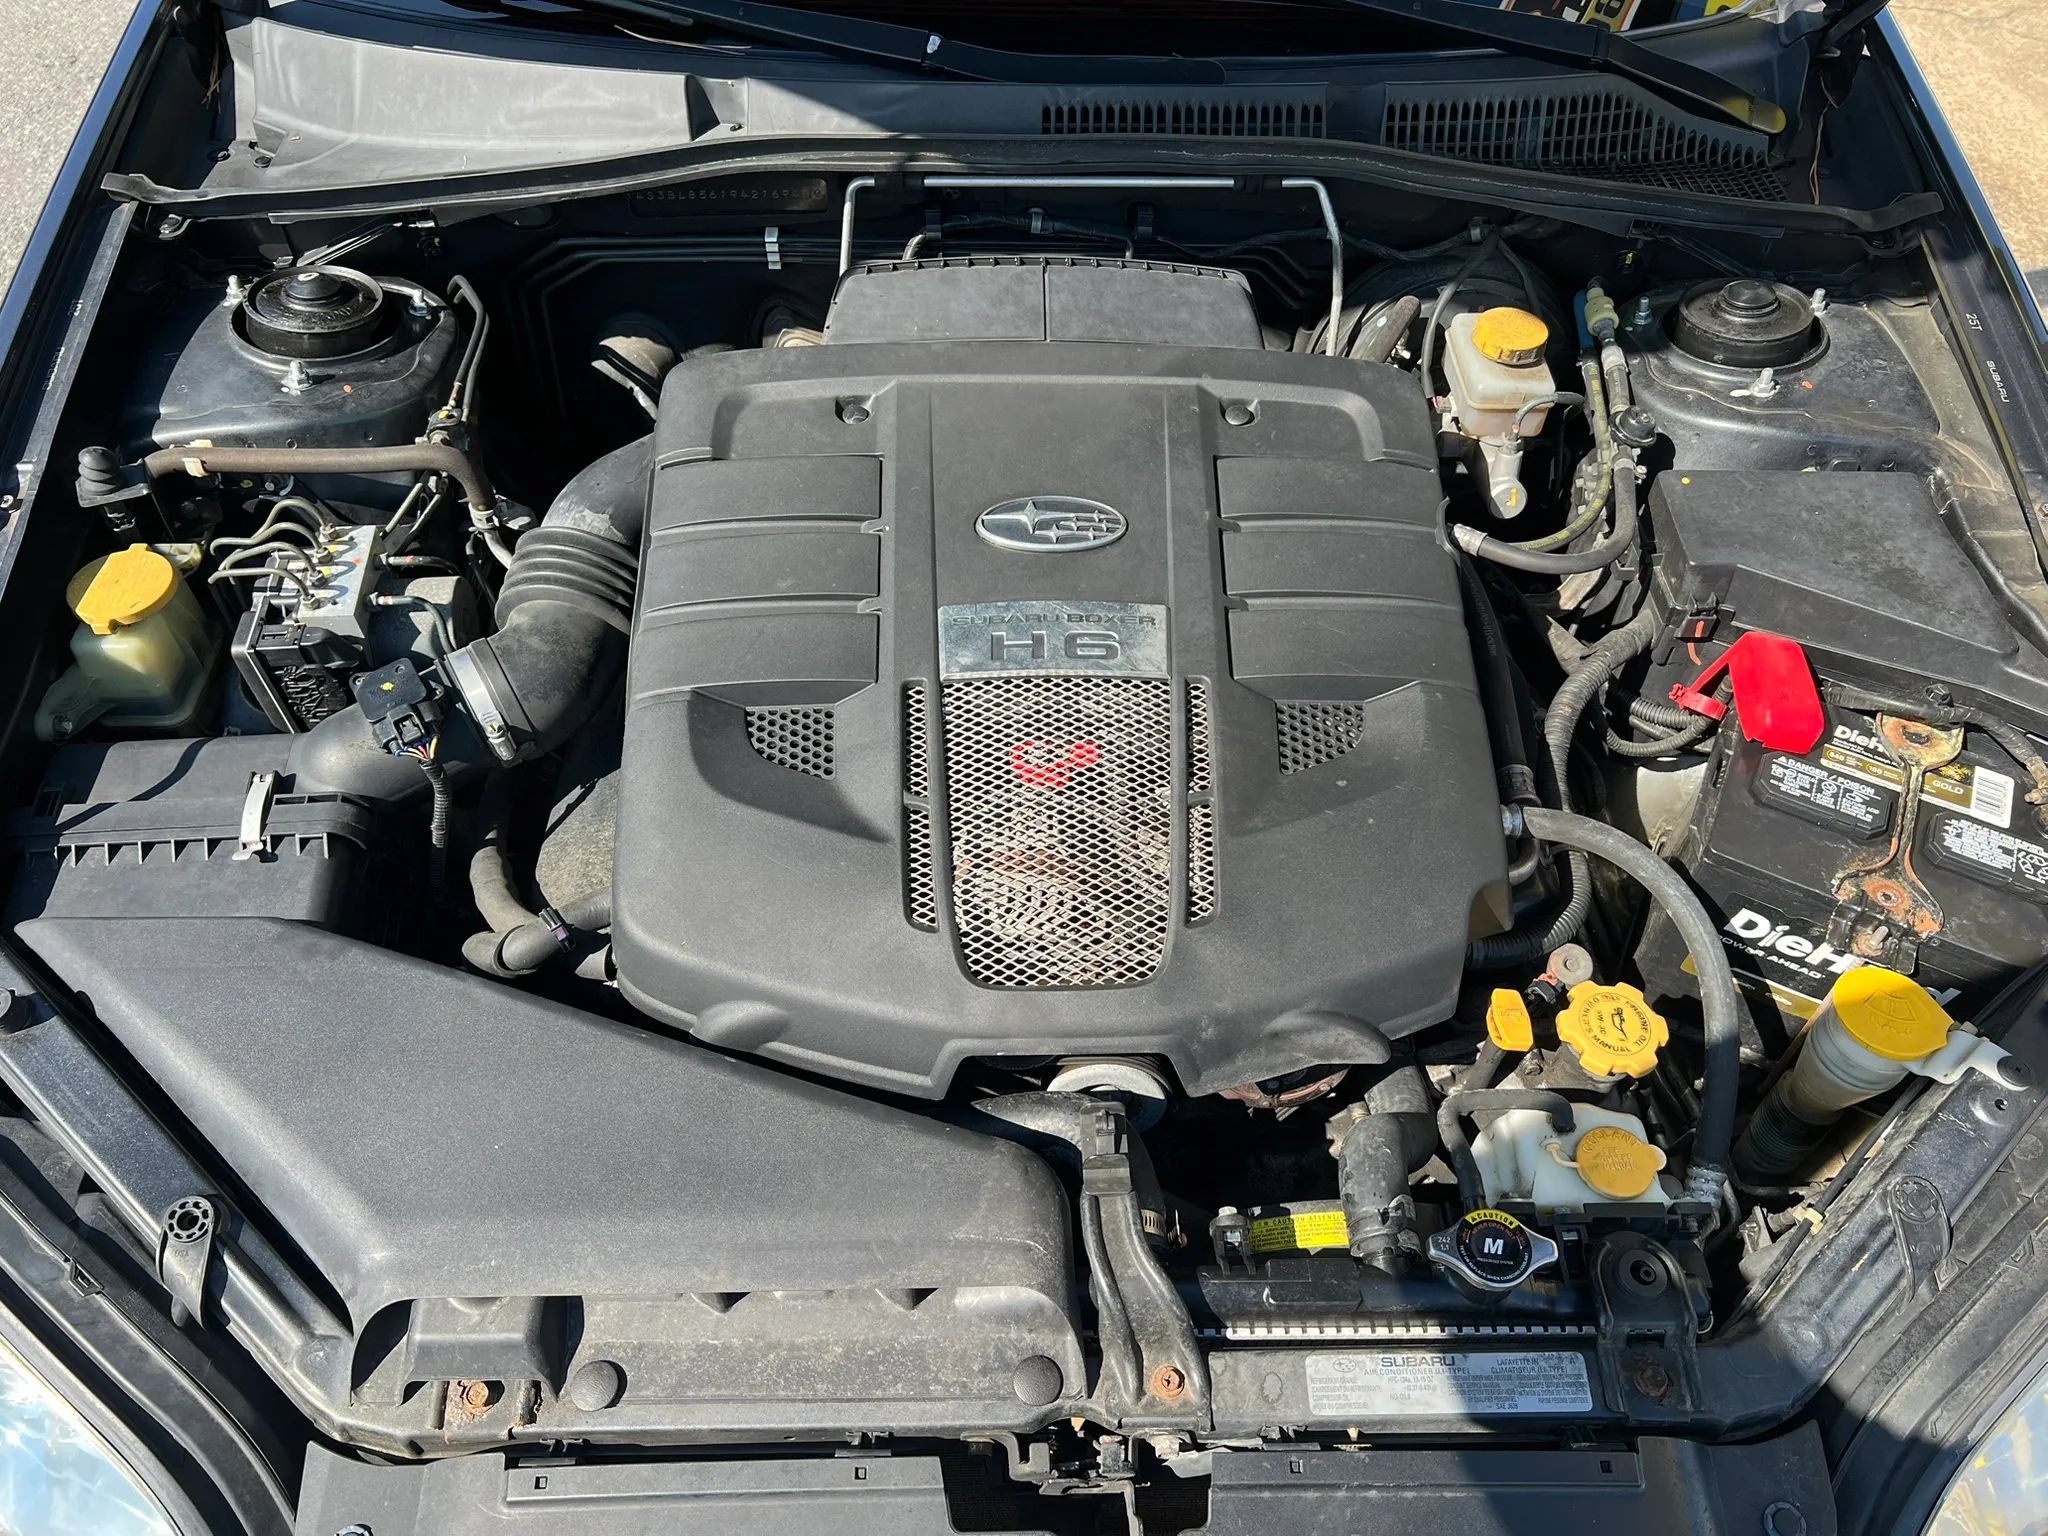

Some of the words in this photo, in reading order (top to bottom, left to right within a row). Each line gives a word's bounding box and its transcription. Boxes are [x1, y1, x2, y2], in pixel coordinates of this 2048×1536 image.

[1965, 313, 1983, 332] 25T
[1986, 360, 2010, 403] SUBARU
[952, 612, 1060, 626] SUBARU
[1067, 613, 1157, 626] BOXER
[1788, 759, 1828, 779] DANGER
[1837, 777, 1875, 796] POISON
[1932, 779, 1964, 795] GOLD
[1716, 935, 1766, 957] OWER
[1767, 955, 1823, 979] AHEAD
[1582, 1128, 1641, 1153] COOLANT
[1272, 1215, 1305, 1225] CAUTION
[1309, 1213, 1346, 1222] ATTENTIO
[1477, 1212, 1514, 1226] CAUTION
[1483, 1237, 1504, 1255] M
[1381, 1355, 1456, 1368] SUBARU
[1363, 1368, 1377, 1376] AIR
[1379, 1367, 1434, 1376] CONDITIONER
[1490, 1366, 1536, 1375] CLIMATISEUR
